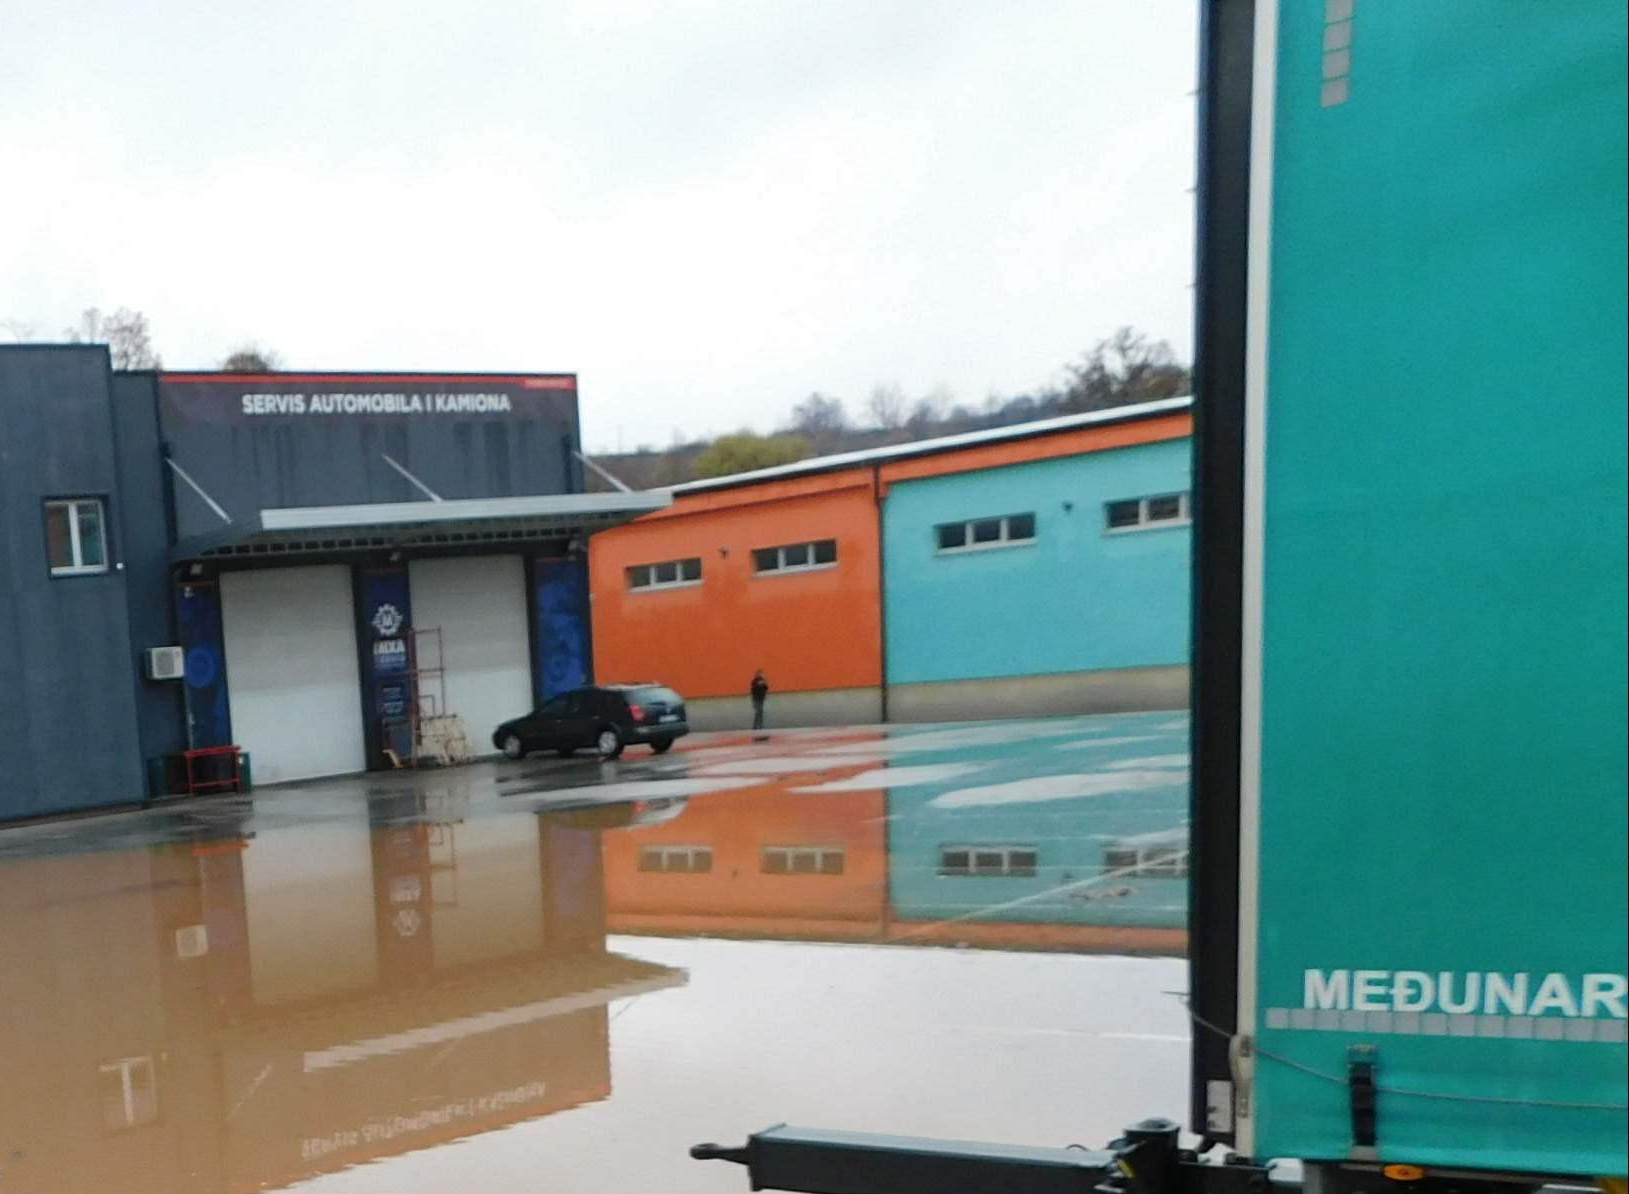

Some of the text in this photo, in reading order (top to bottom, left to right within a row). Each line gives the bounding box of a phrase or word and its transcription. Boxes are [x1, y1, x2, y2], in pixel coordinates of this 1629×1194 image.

[242, 393, 511, 414] SERVIS AUTOMOBILA I KAMIONA
[1304, 968, 1628, 1017] MEĐUNAR
